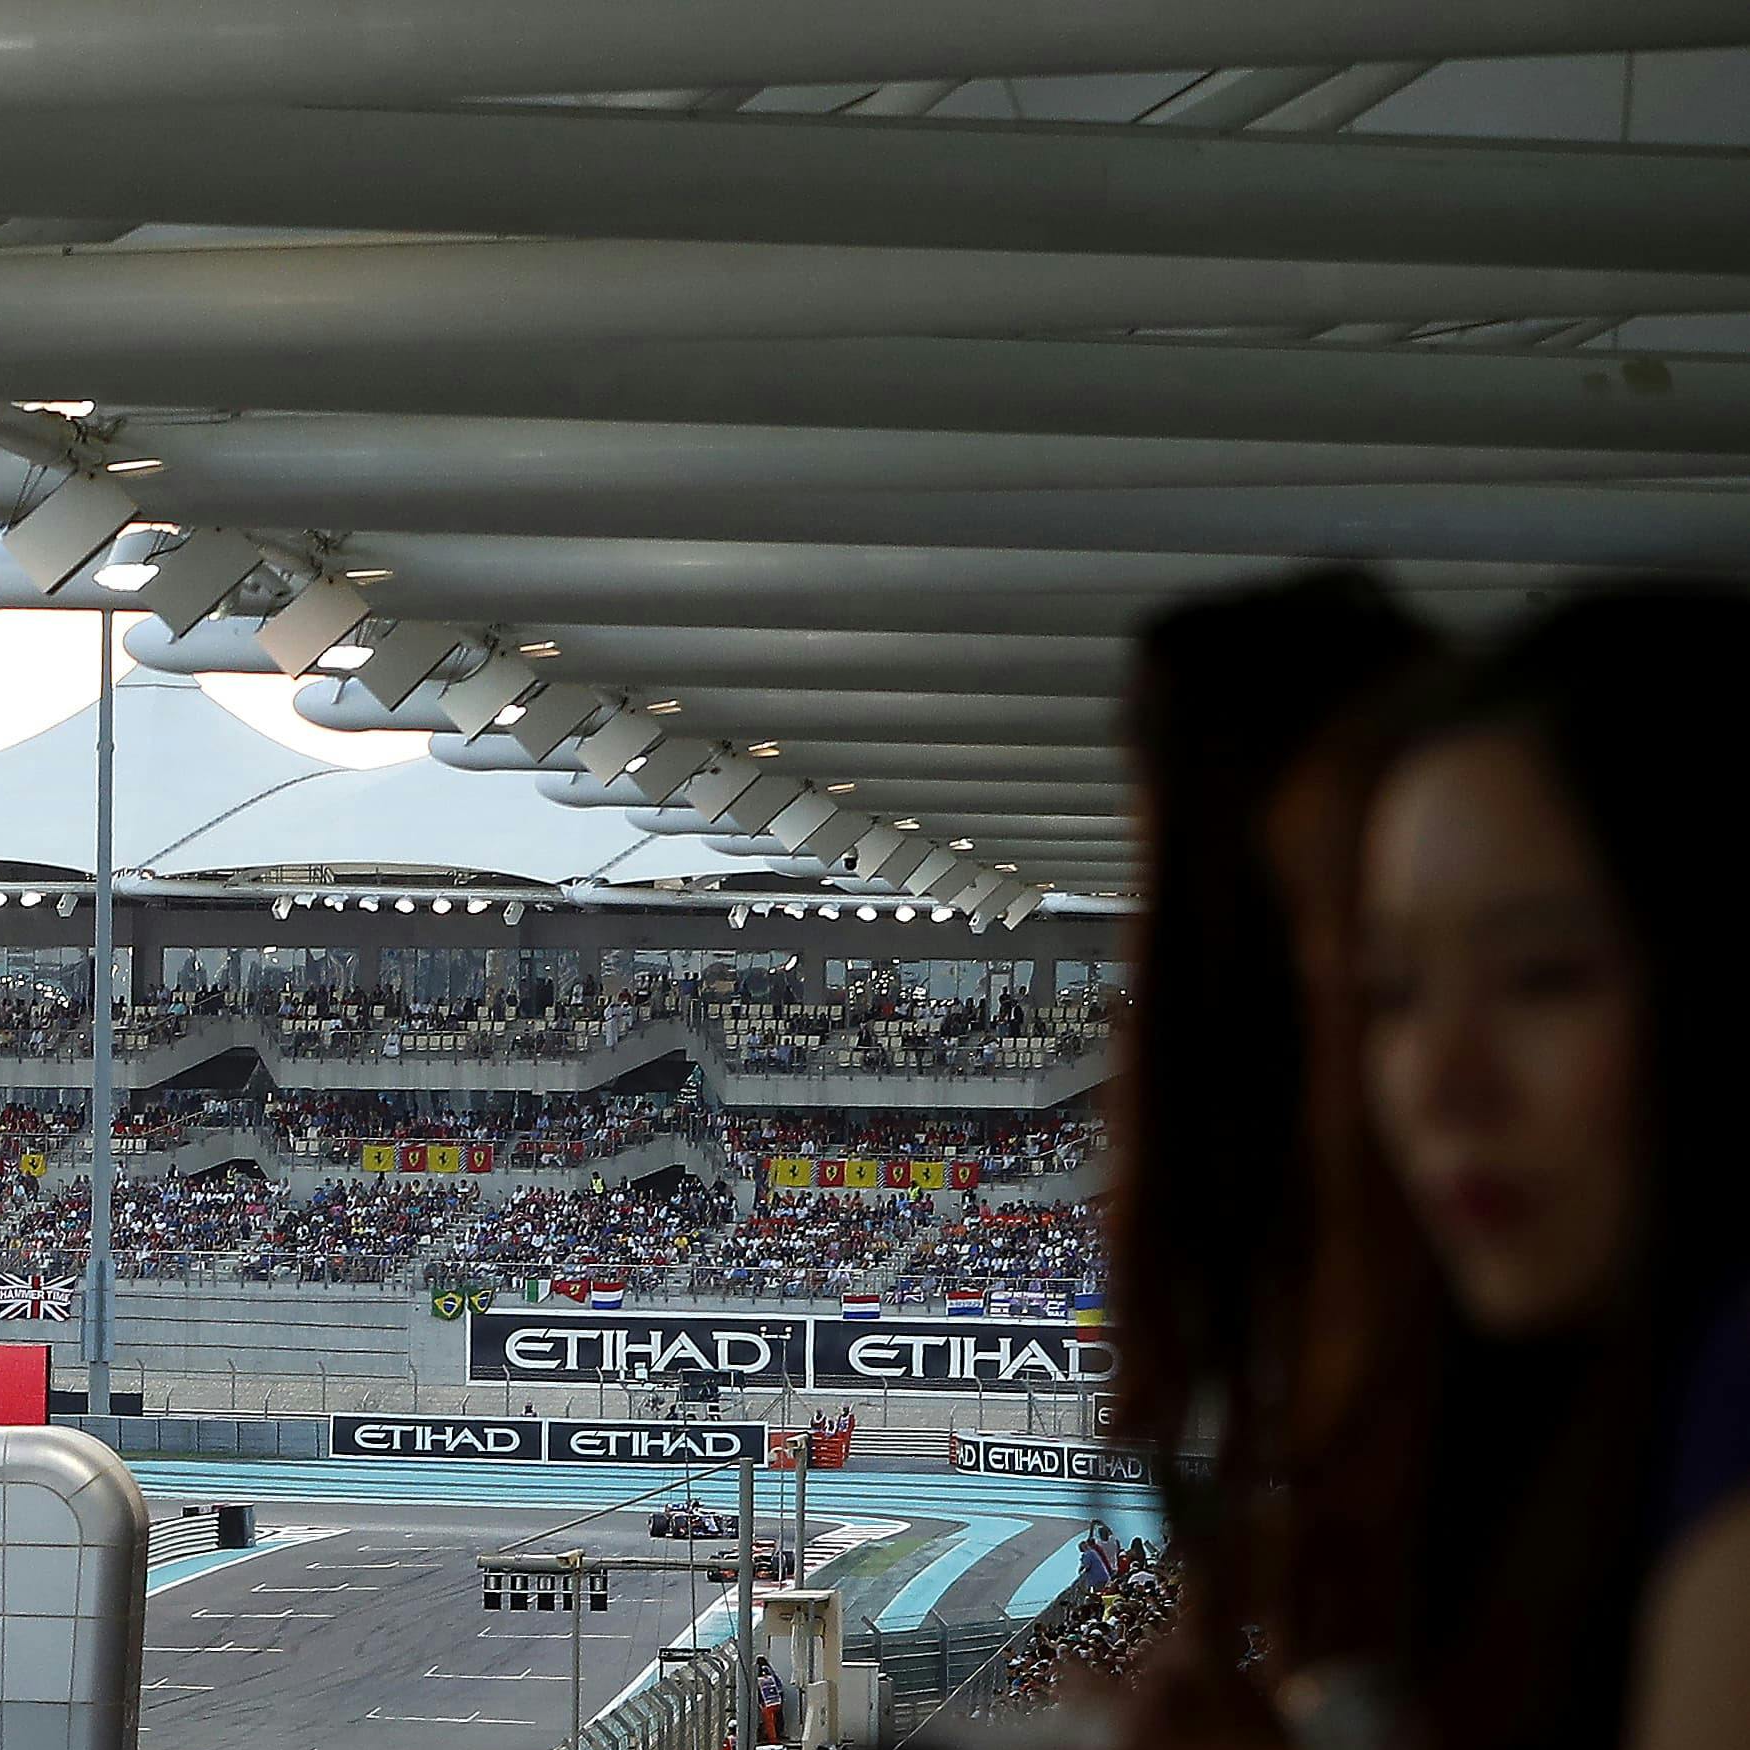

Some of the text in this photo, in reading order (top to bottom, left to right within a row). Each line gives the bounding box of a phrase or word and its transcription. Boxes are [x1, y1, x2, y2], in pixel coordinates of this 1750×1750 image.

[505, 1327, 772, 1374] ETIHAD
[848, 1334, 1119, 1382] ETIHAD
[353, 1423, 521, 1453] ETIHAD
[569, 1431, 741, 1457] ETIHAD
[988, 1447, 1059, 1473] ETIHAD
